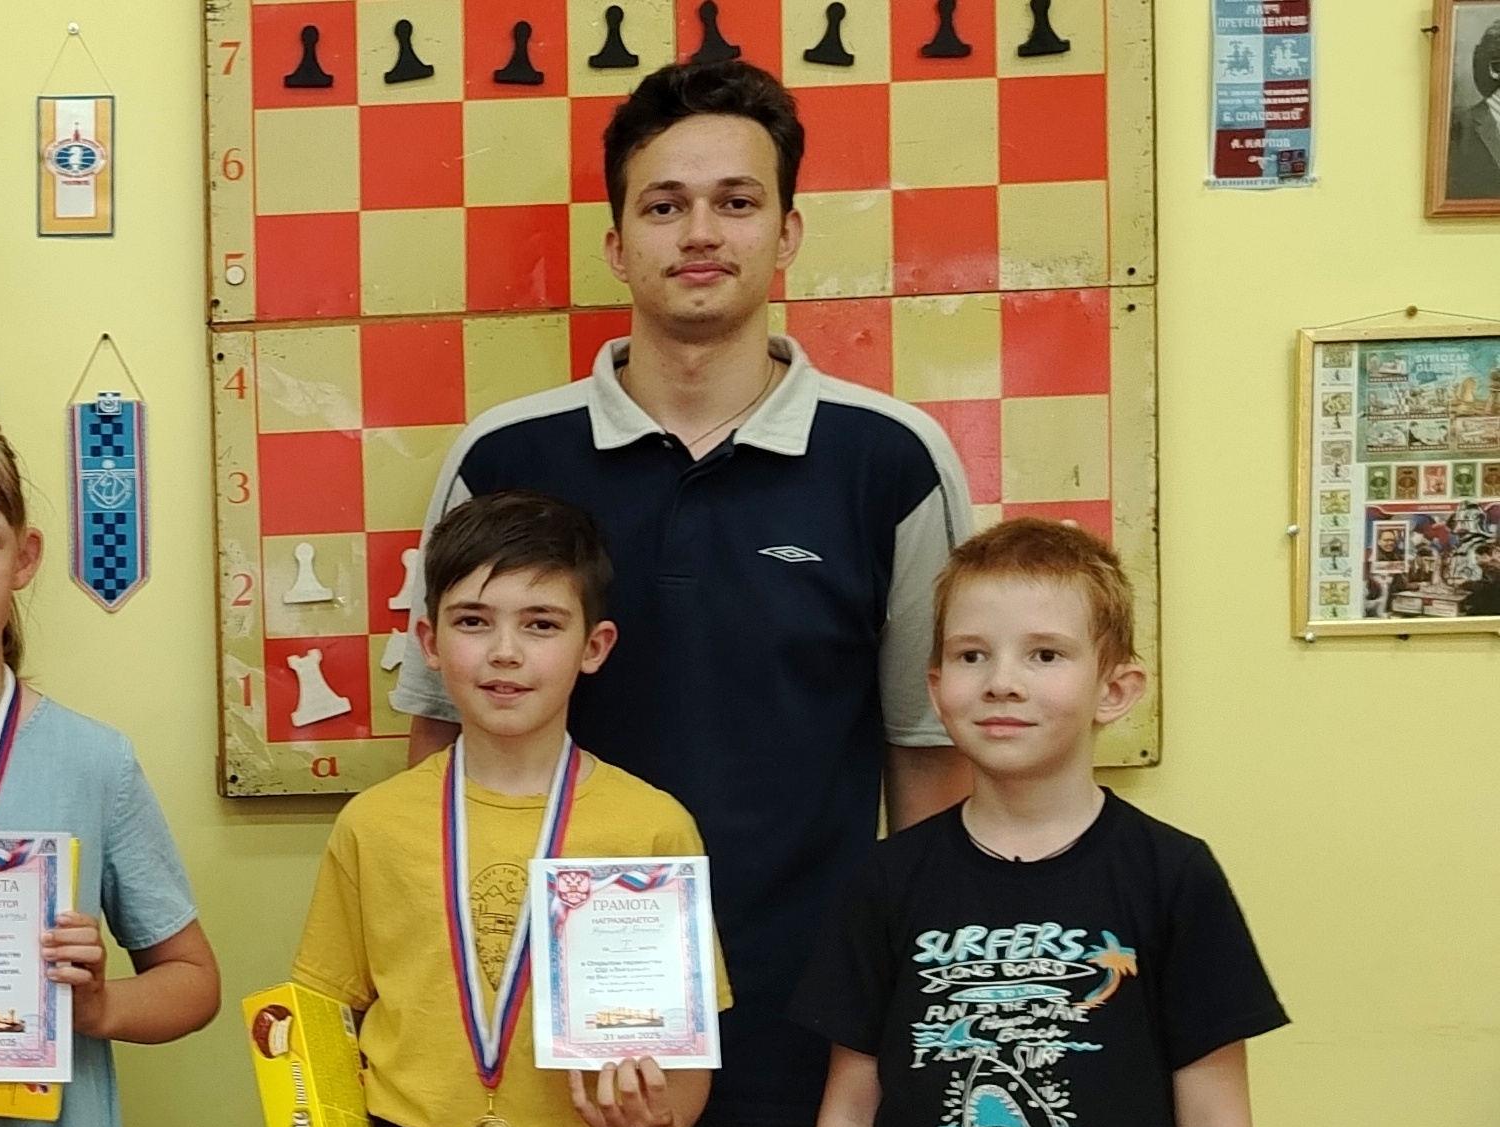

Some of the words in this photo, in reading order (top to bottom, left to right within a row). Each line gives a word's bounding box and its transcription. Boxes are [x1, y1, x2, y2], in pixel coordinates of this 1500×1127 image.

[219, 40, 242, 76] 7
[220, 147, 245, 181] 6
[223, 366, 248, 400] 4
[227, 471, 251, 504] 3
[230, 572, 254, 607] 2
[239, 673, 253, 707] 1
[310, 756, 341, 779] a
[591, 916, 660, 925] НАГРАЖДАЕТСЯ
[592, 898, 661, 911] ГРАМОТА
[911, 922, 1088, 965] SURFERS
[941, 964, 996, 980] LONG
[1001, 961, 1067, 977] BOARD
[1000, 999, 1030, 1013] THE
[1028, 1003, 1091, 1023] WAVE
[603, 1033, 615, 1041] 31
[637, 1032, 662, 1040] 2025
